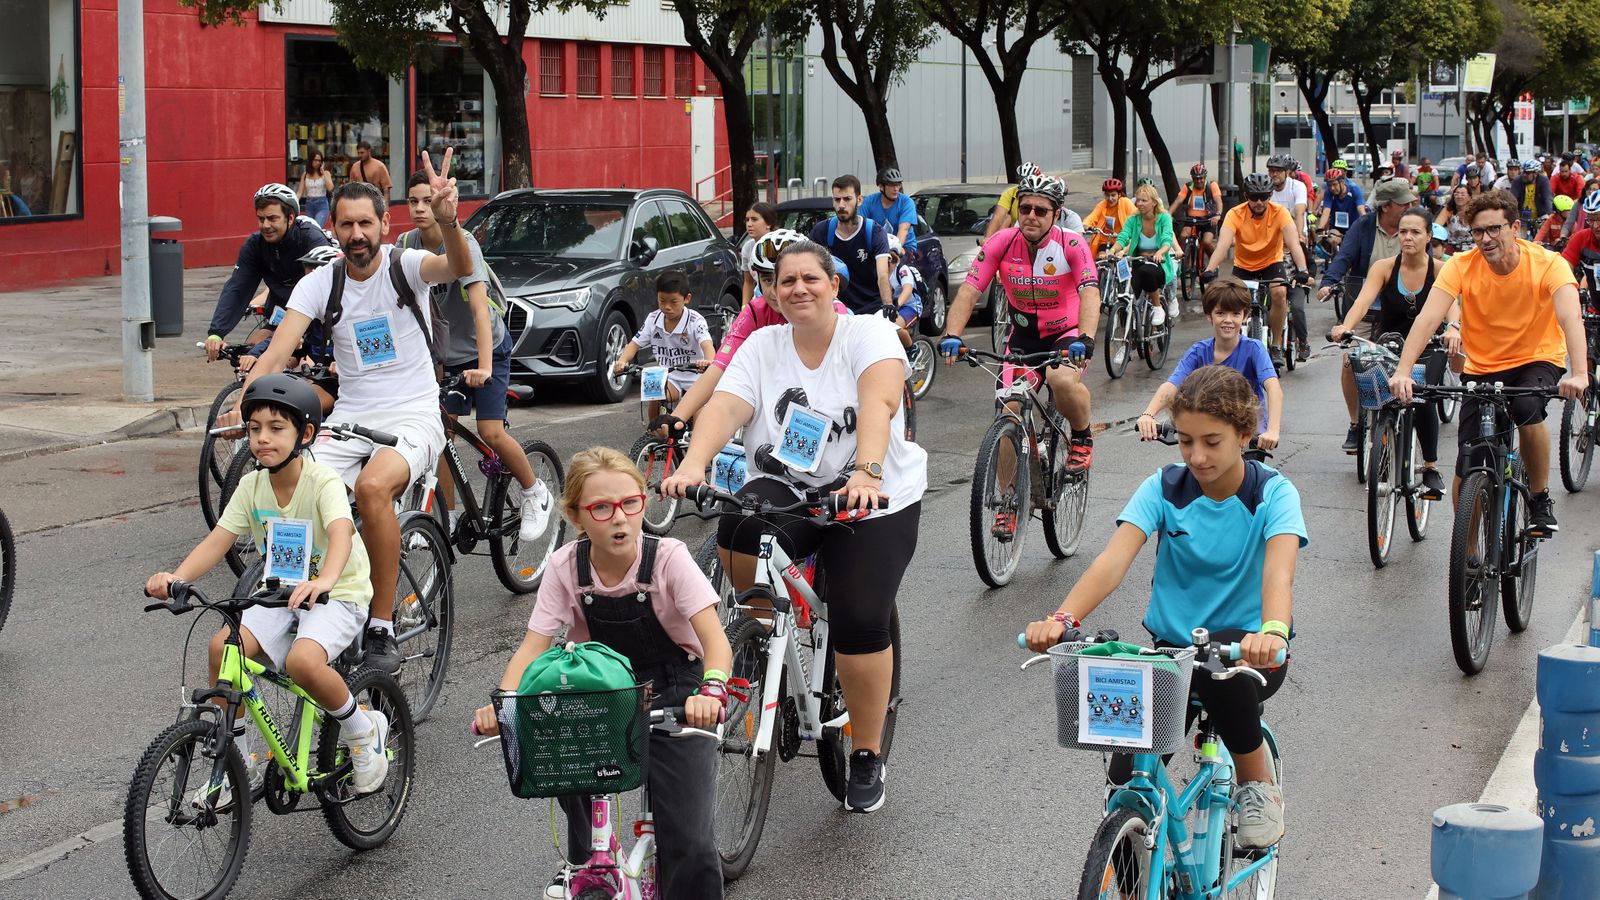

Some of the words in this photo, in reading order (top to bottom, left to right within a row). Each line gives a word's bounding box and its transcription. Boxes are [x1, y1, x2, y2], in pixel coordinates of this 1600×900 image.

[1008, 274, 1044, 286] indeso
[651, 344, 697, 358] Emirates
[447, 438, 467, 484] ROCKRIDER
[1095, 676, 1107, 684] BICI
[1107, 677, 1137, 686] AMISTAD
[257, 705, 301, 772] ROCKRIDER
